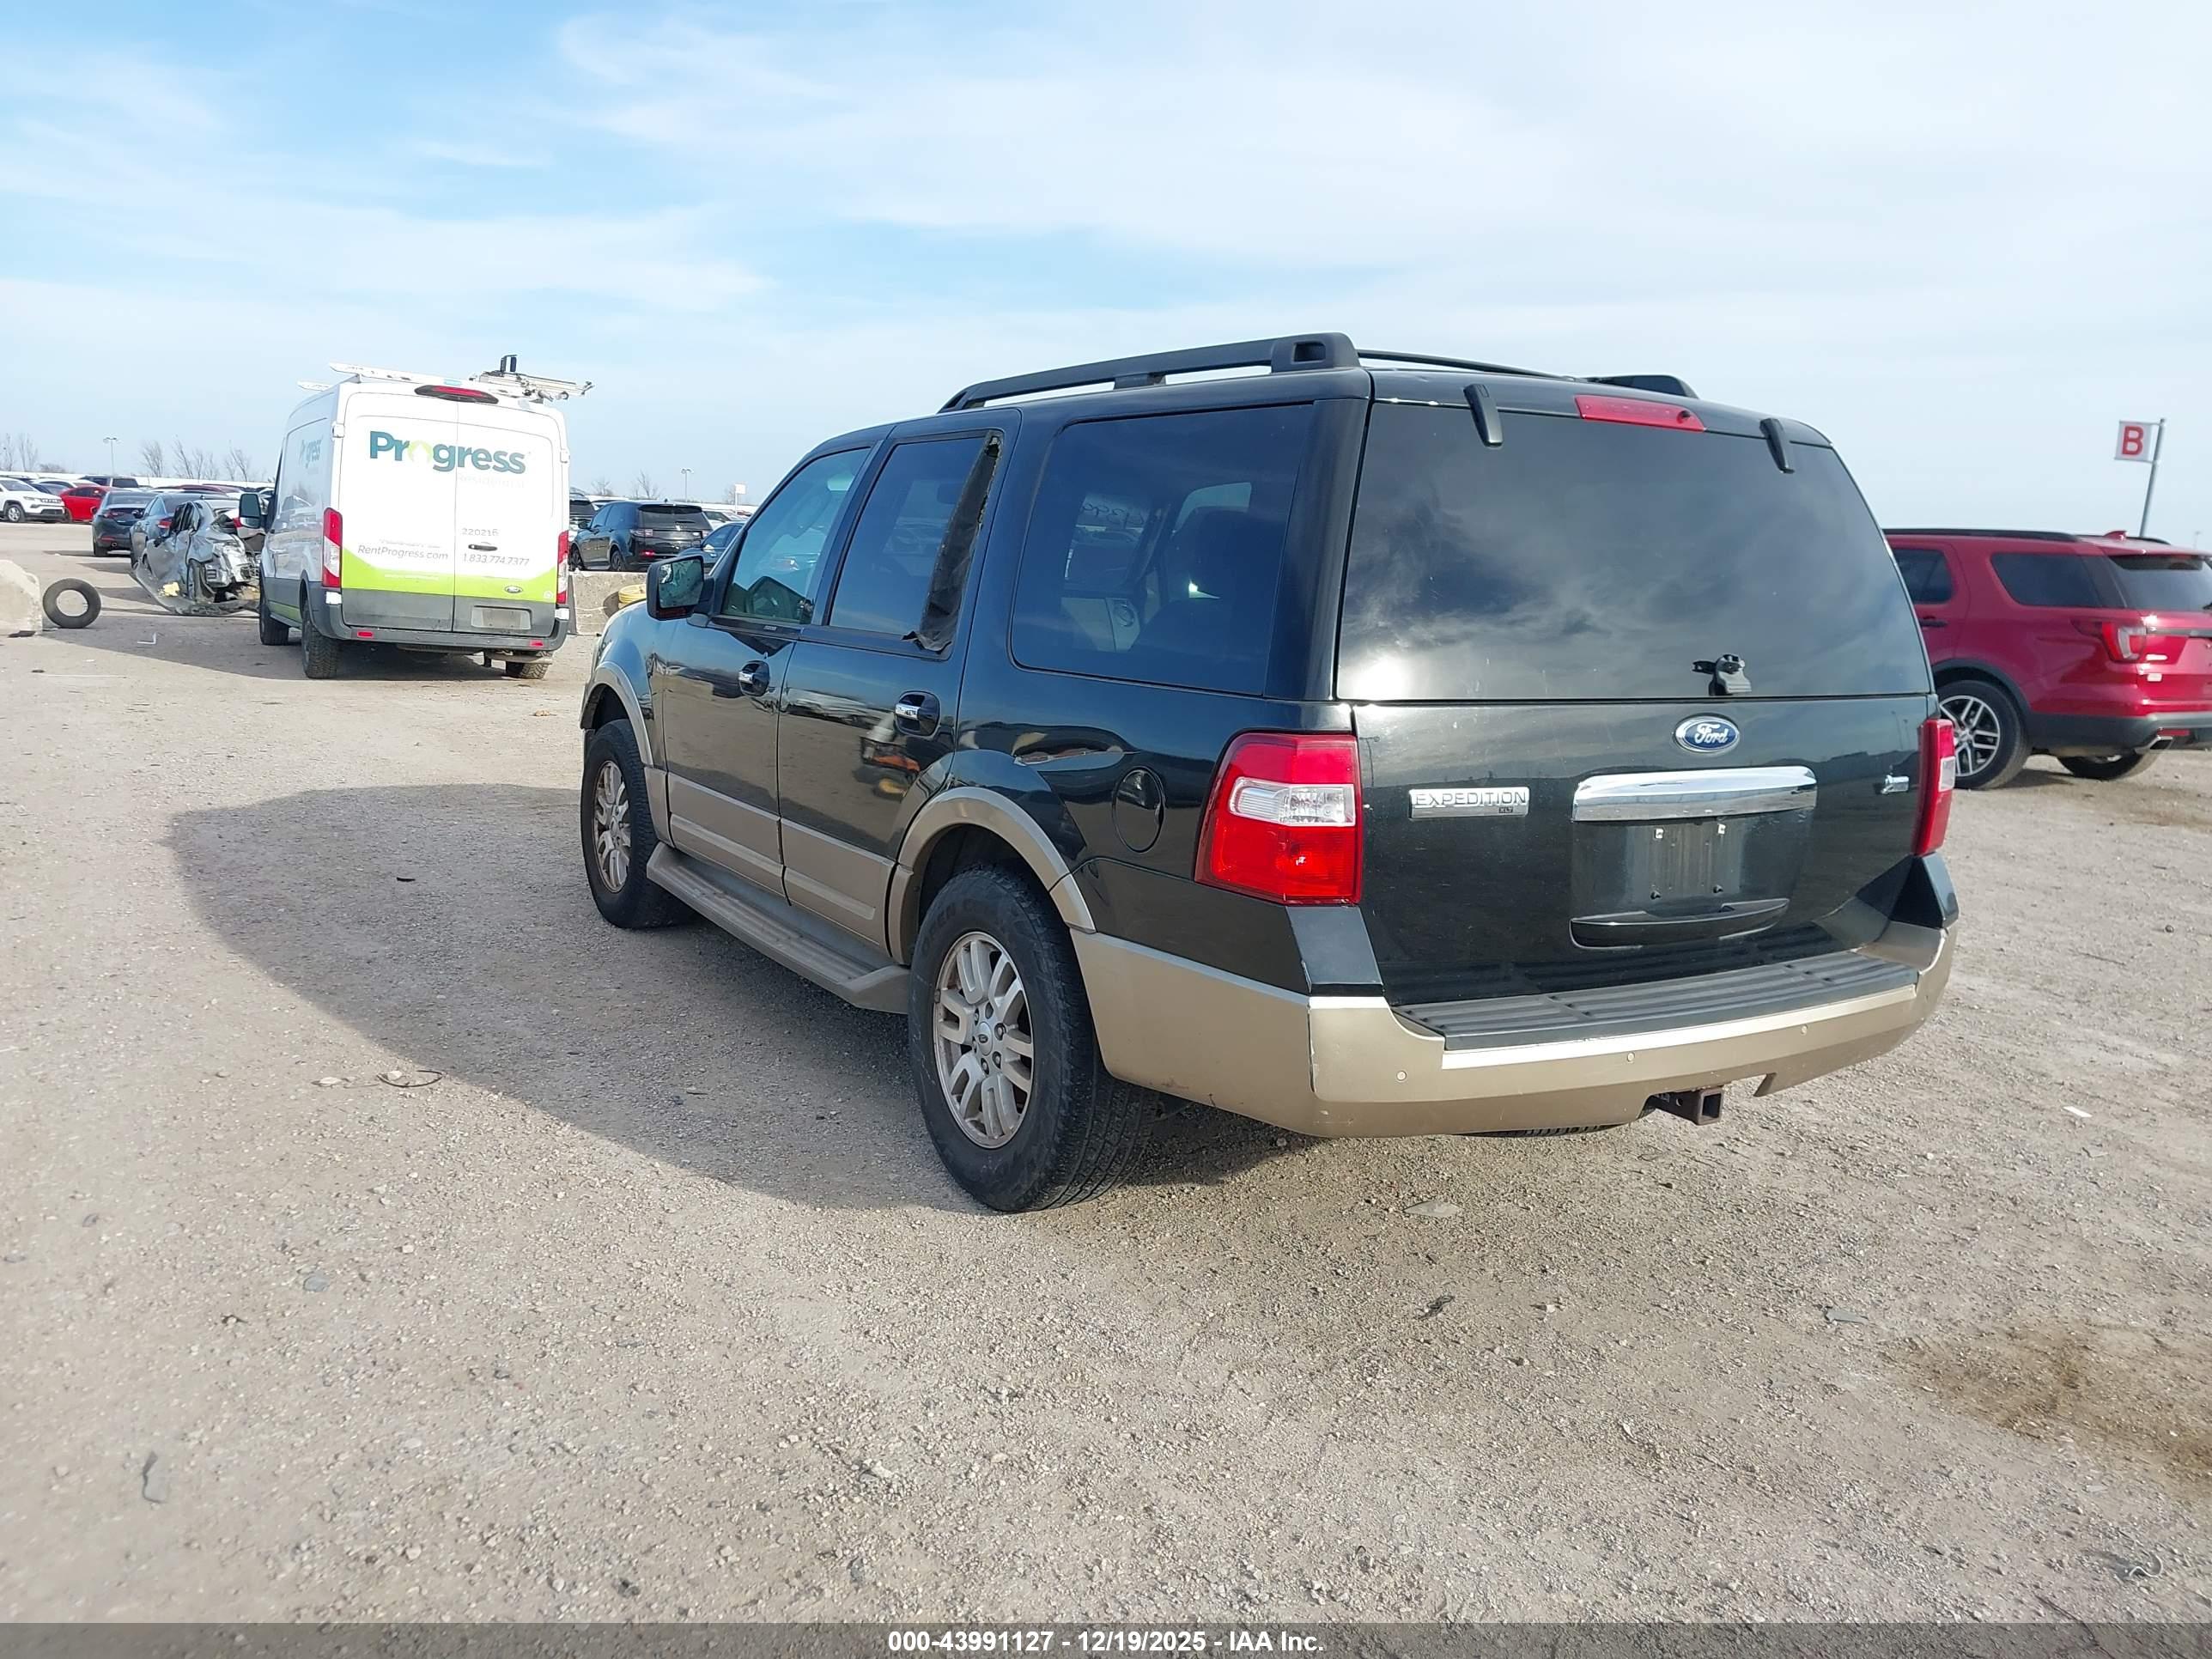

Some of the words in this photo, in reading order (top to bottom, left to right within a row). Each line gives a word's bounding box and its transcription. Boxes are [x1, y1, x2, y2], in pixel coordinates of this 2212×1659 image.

[2121, 425, 2144, 456] B
[369, 430, 526, 475] Progress
[357, 544, 449, 561] RentProgress.com
[1693, 723, 1729, 744] Ford
[1415, 791, 1527, 807] EXPEDITION
